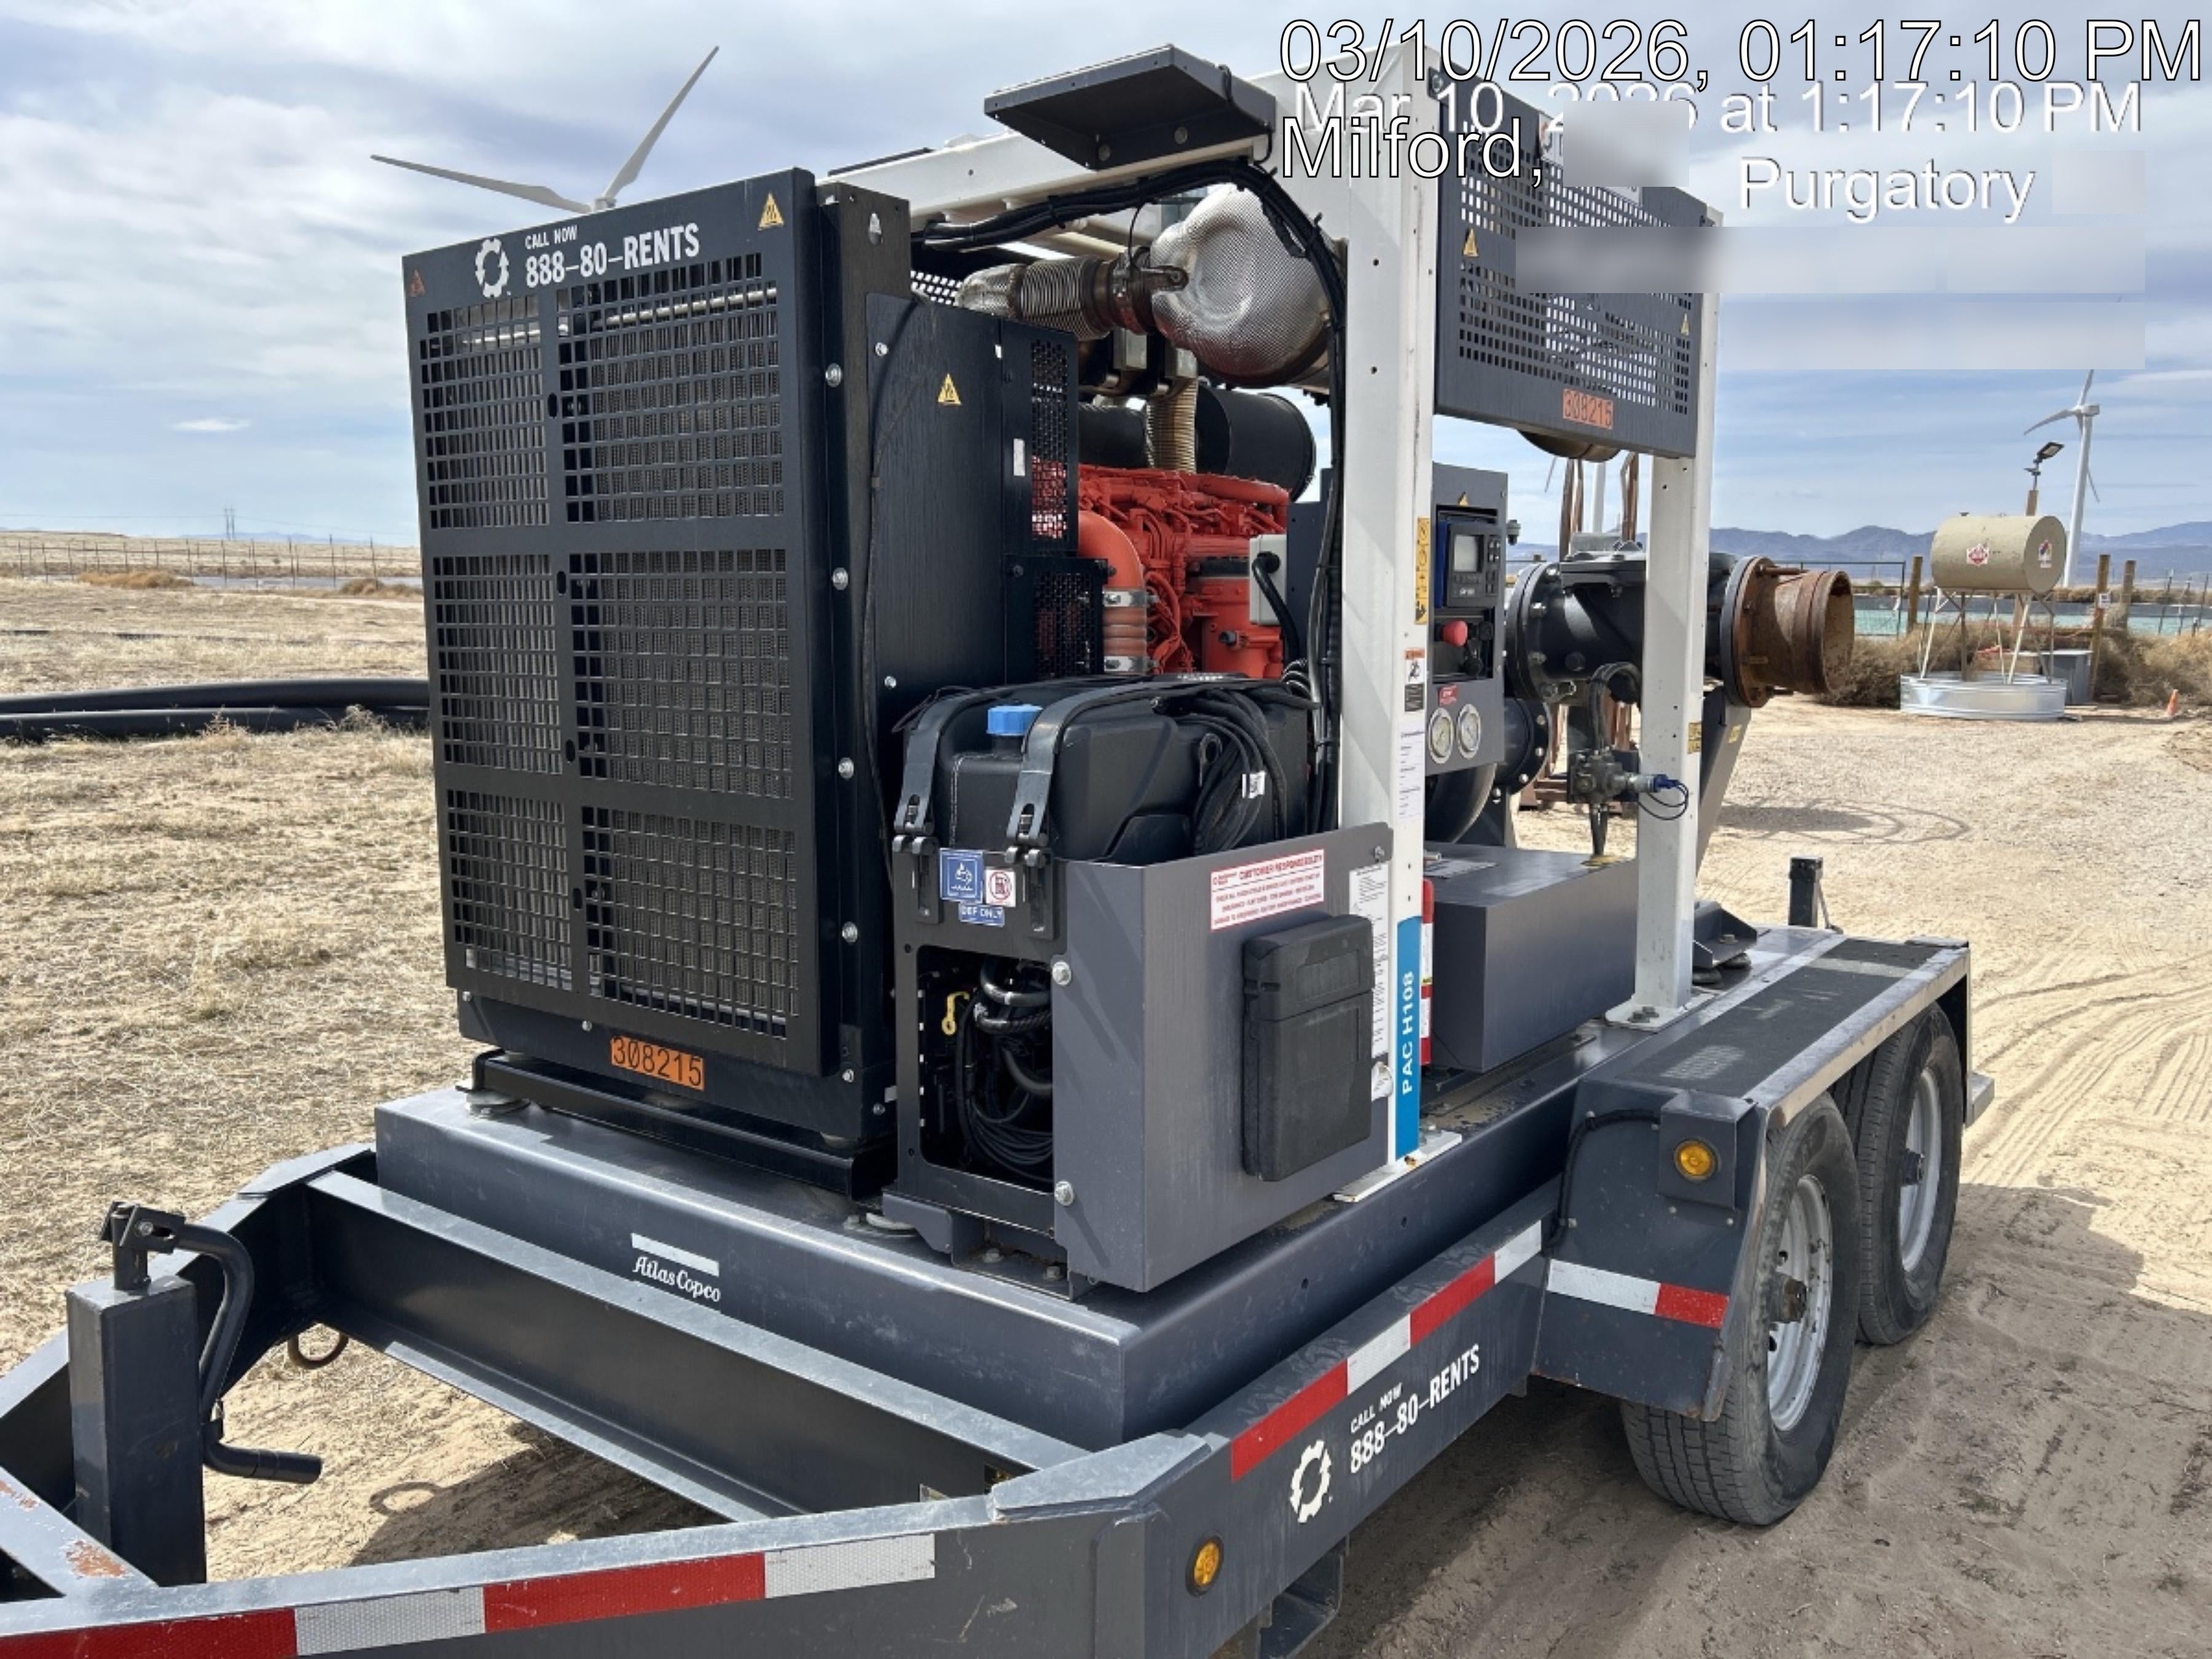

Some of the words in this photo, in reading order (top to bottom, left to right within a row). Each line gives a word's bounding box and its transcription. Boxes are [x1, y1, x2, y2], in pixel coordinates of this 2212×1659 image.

[525, 231, 550, 249] CALL
[554, 224, 578, 245] NOW
[525, 222, 699, 288] 888-80-RENTS
[1564, 390, 1612, 426] 308215
[1402, 971, 1414, 1035] H108
[613, 1037, 702, 1086] 308215
[1402, 1041, 1413, 1096] PAC
[632, 1256, 675, 1286] Atlas
[676, 1269, 721, 1302] Copco
[1351, 1404, 1376, 1433] CALL
[1378, 1382, 1403, 1412] NOW
[1351, 1343, 1480, 1474] 888-80-RENTS
